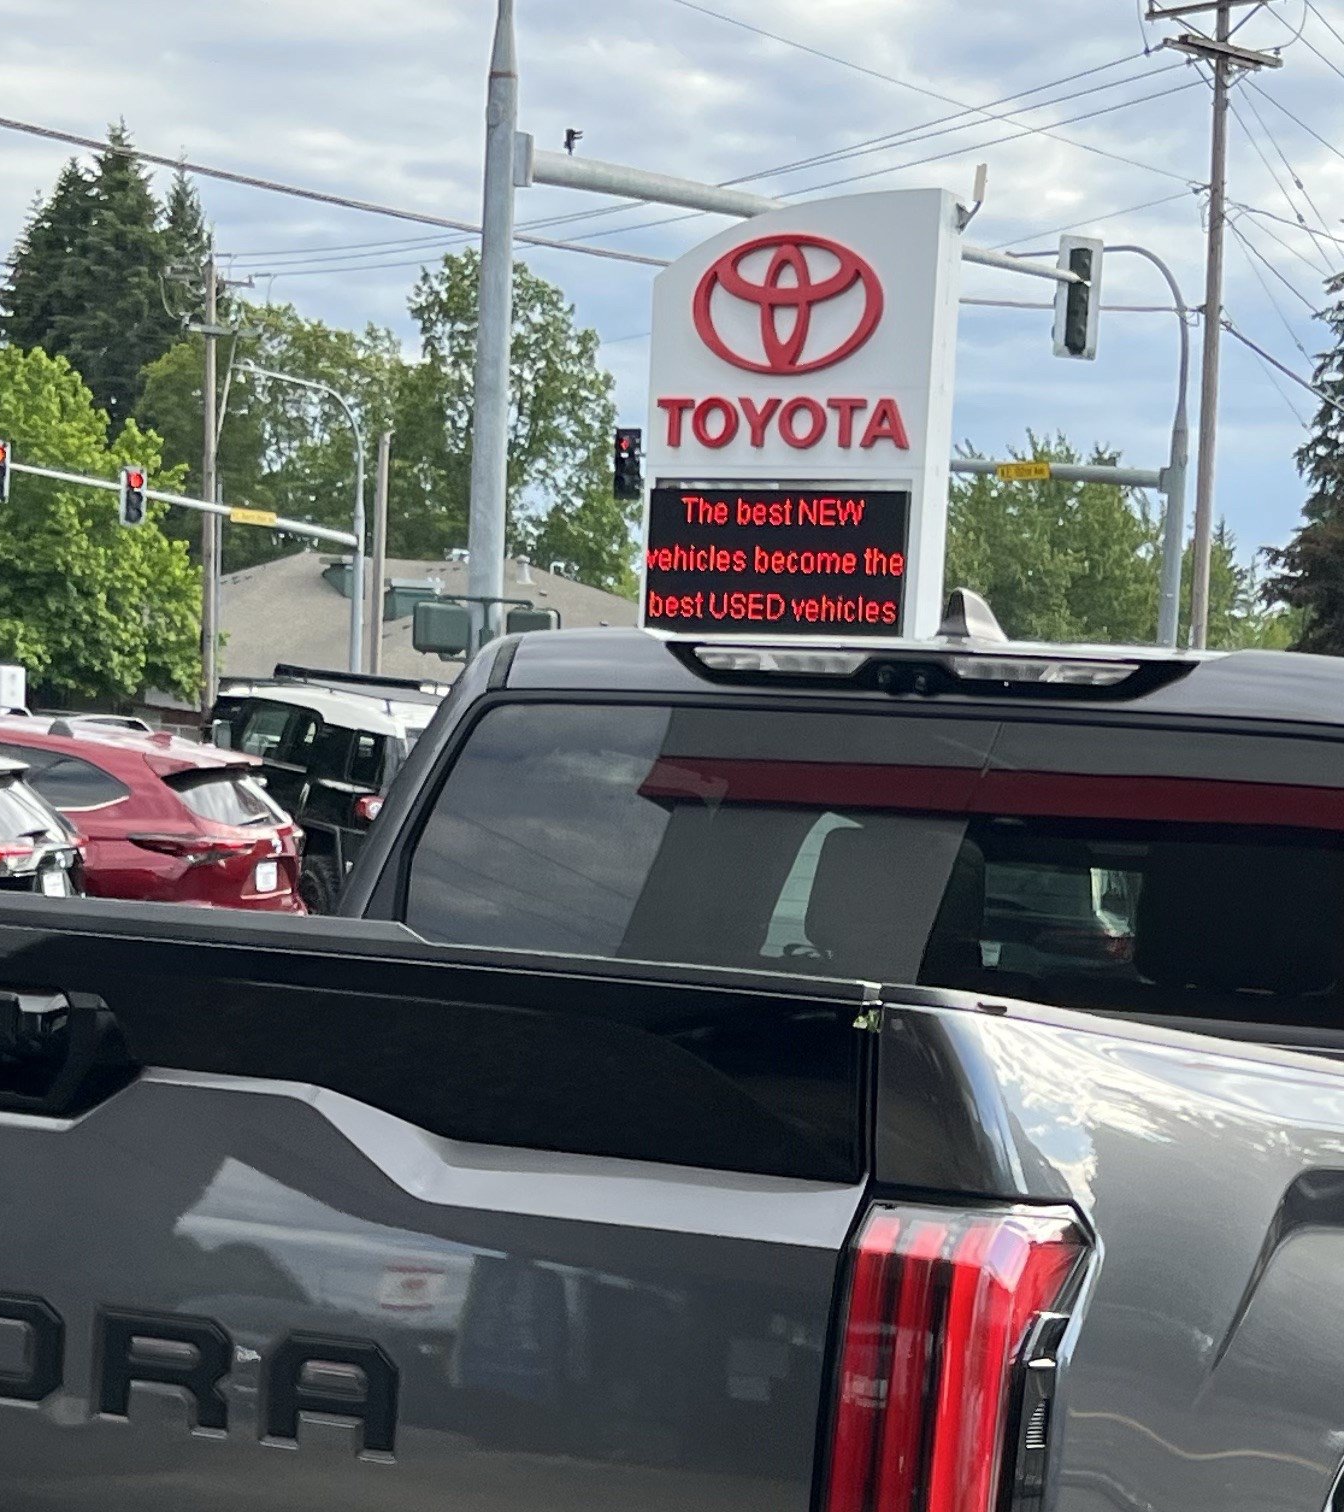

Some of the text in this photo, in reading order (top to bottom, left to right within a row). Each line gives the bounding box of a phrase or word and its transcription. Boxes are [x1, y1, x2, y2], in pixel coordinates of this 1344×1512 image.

[657, 397, 909, 450] TOYOTA
[681, 496, 866, 527] The best NEW
[646, 543, 905, 577] vehicles become the
[648, 590, 898, 624] best USED vehicles
